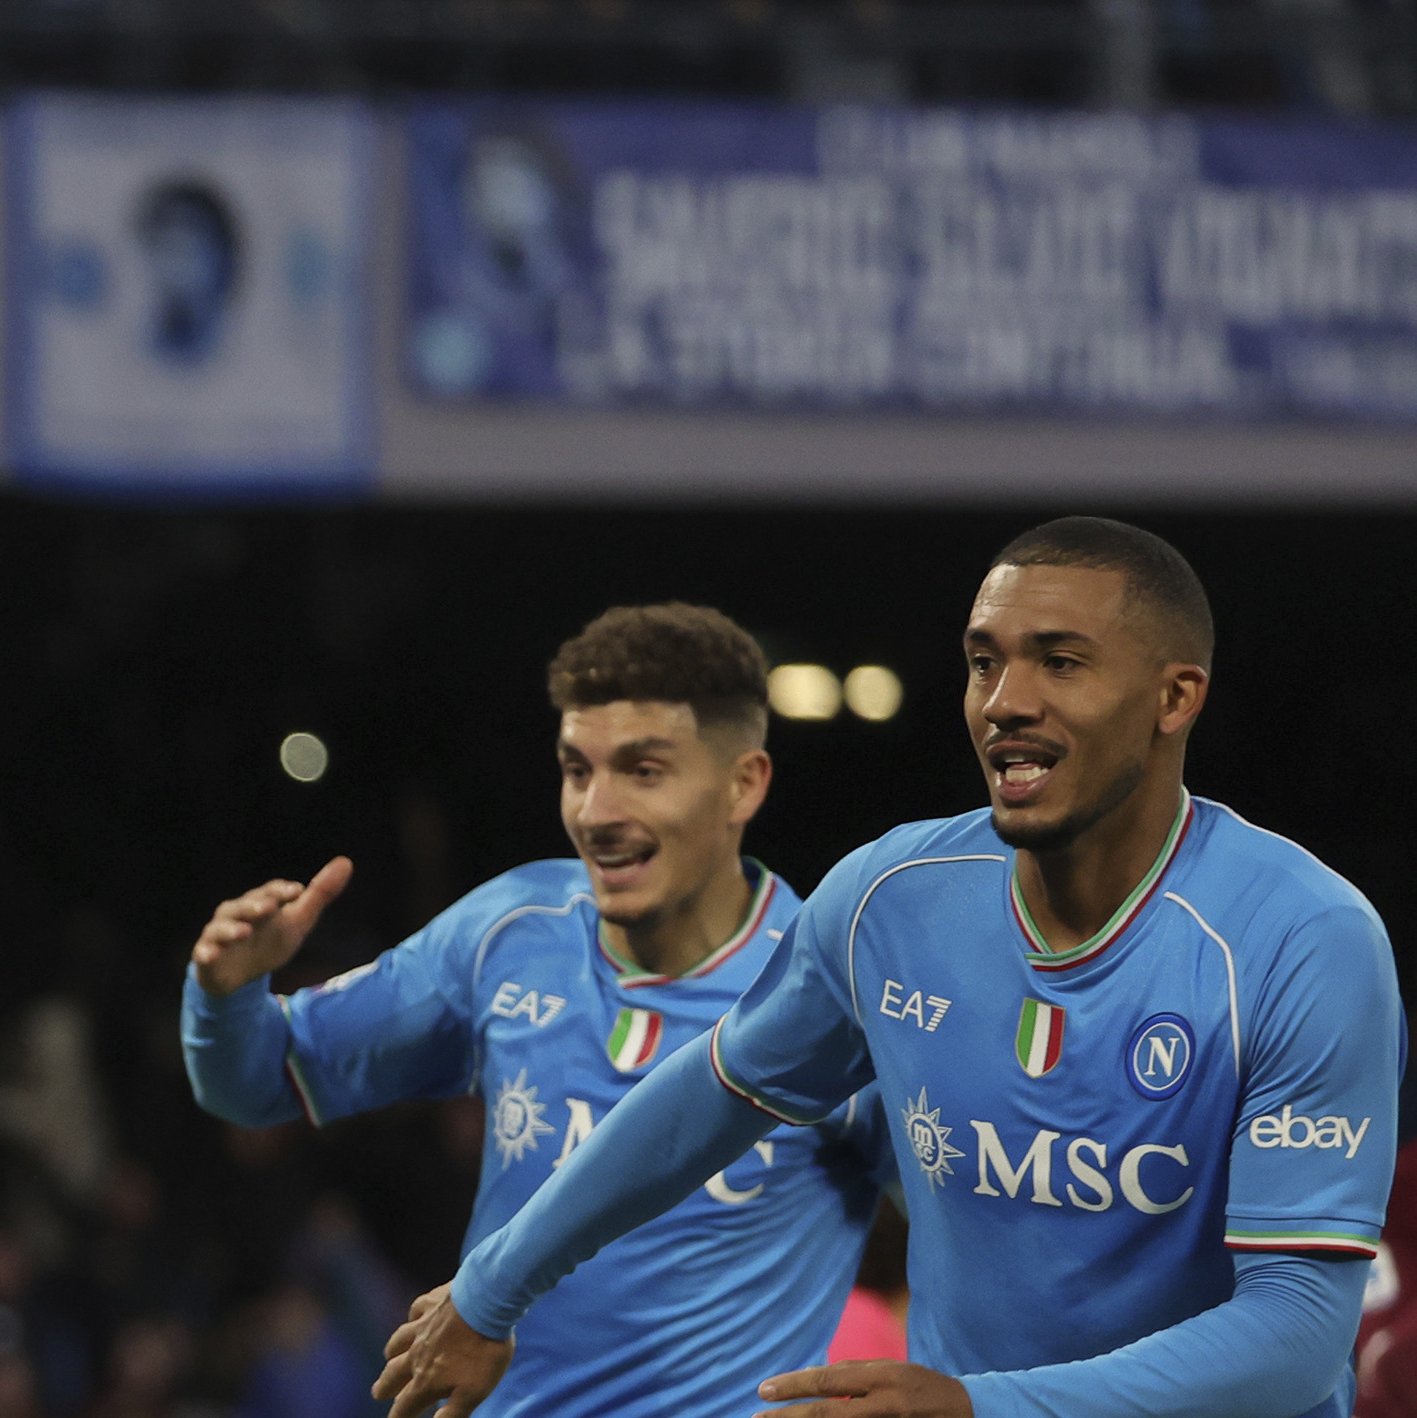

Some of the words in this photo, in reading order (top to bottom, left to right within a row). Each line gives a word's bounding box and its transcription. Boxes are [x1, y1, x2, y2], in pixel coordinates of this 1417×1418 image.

[491, 981, 567, 1029] EA7
[879, 979, 952, 1032] EA7
[1144, 1036, 1181, 1077] N
[1249, 1104, 1372, 1160] ebay
[969, 1119, 1195, 1215] MSC
